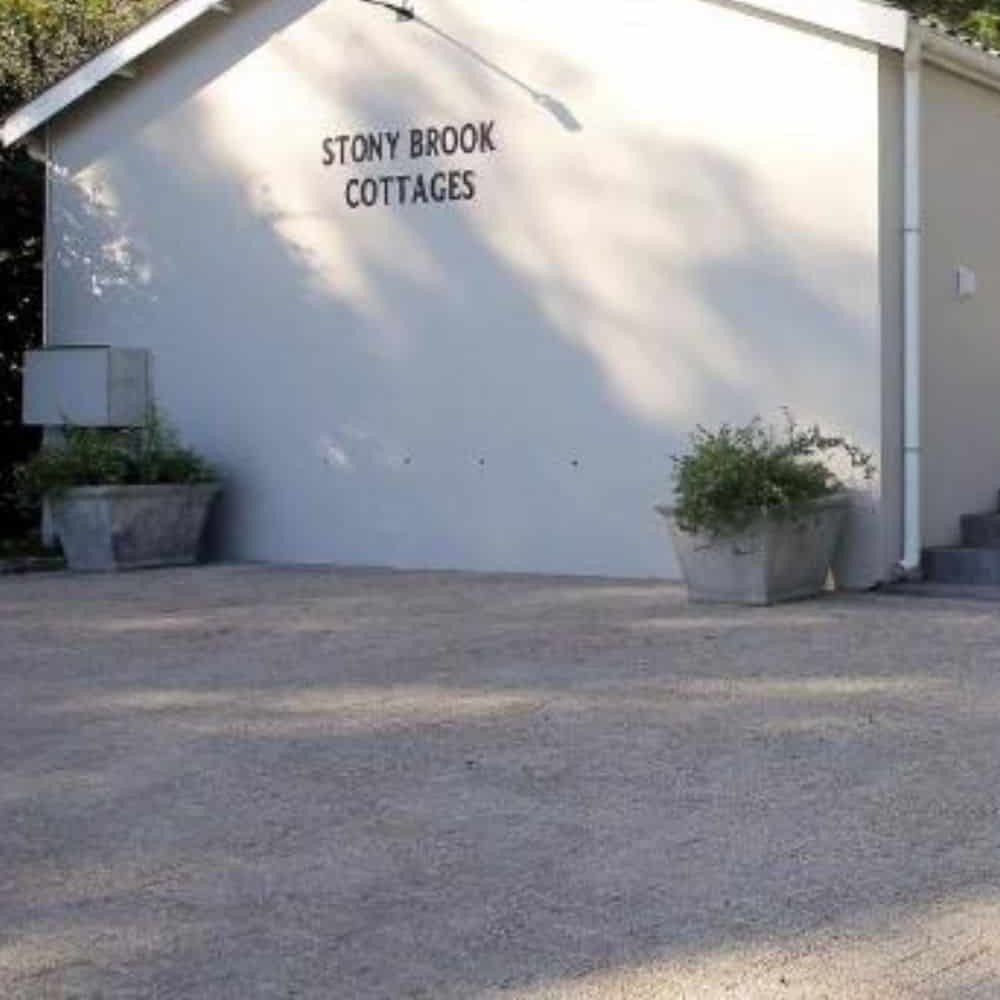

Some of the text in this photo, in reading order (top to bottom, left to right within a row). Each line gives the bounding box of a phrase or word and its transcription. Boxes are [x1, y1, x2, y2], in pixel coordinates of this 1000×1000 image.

[321, 120, 497, 166] STONY BROOK
[344, 169, 476, 209] COTTAGES
